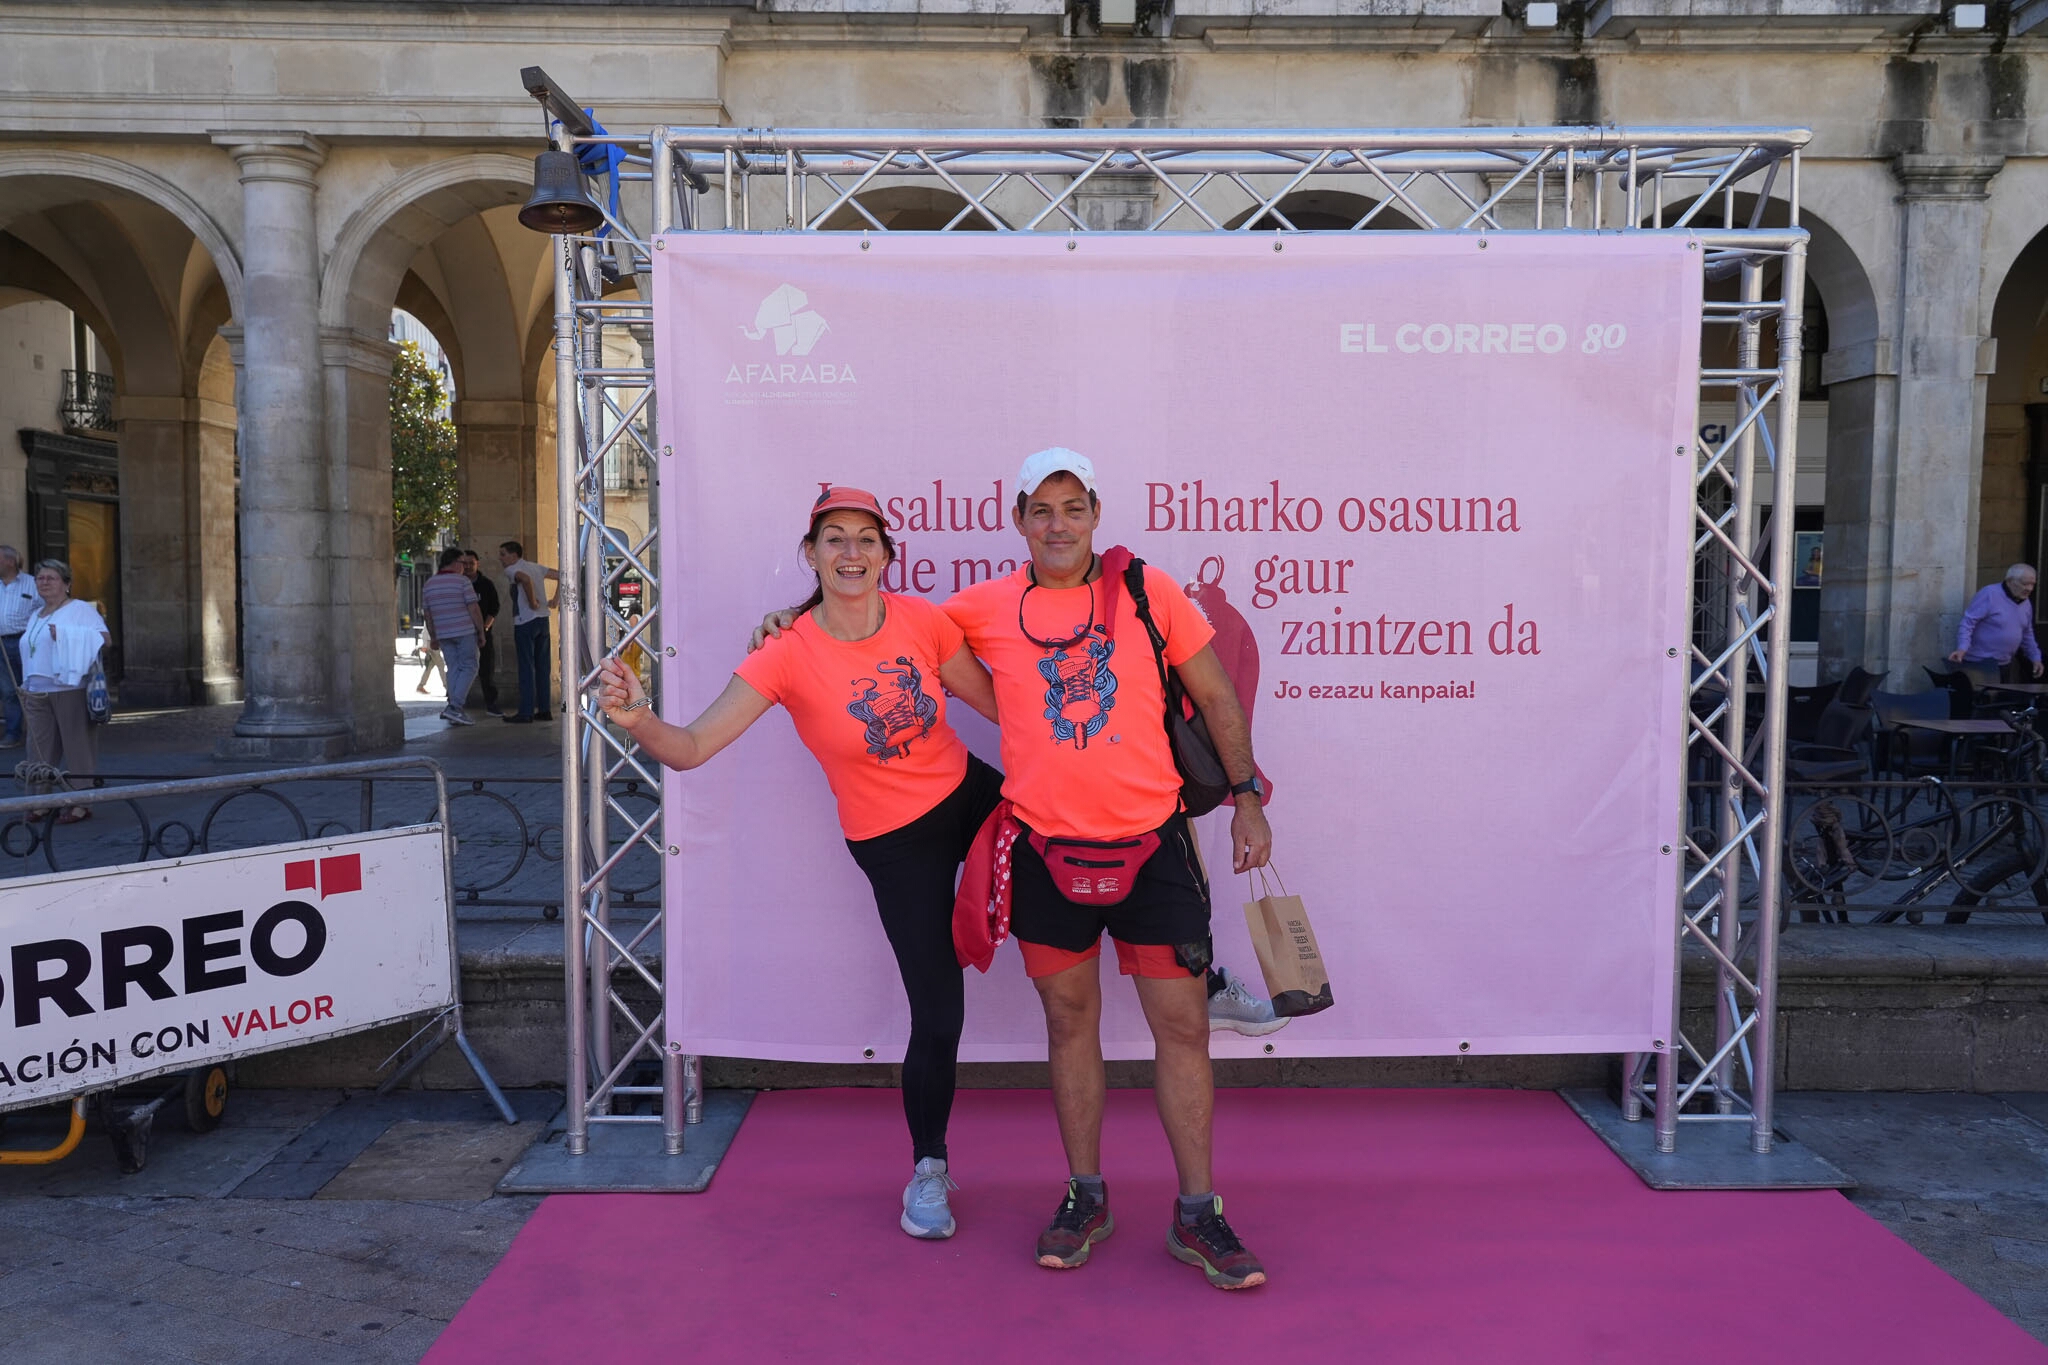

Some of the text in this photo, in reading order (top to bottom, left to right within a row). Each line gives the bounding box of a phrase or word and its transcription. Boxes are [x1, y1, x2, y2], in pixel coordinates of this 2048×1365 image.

[1340, 323, 1626, 353] EL CORREO 80
[725, 363, 857, 384] AFARABA
[886, 479, 1005, 532] salud
[1145, 480, 1521, 532] Biharko osasuna
[882, 542, 936, 593] de
[1251, 554, 1354, 609] gaur
[1280, 603, 1541, 655] zaintzen da
[1274, 681, 1476, 703] Jo ezazu kanpaia!
[0, 900, 327, 1028] RREO
[130, 1020, 210, 1058] CON
[222, 995, 335, 1039] VALOR
